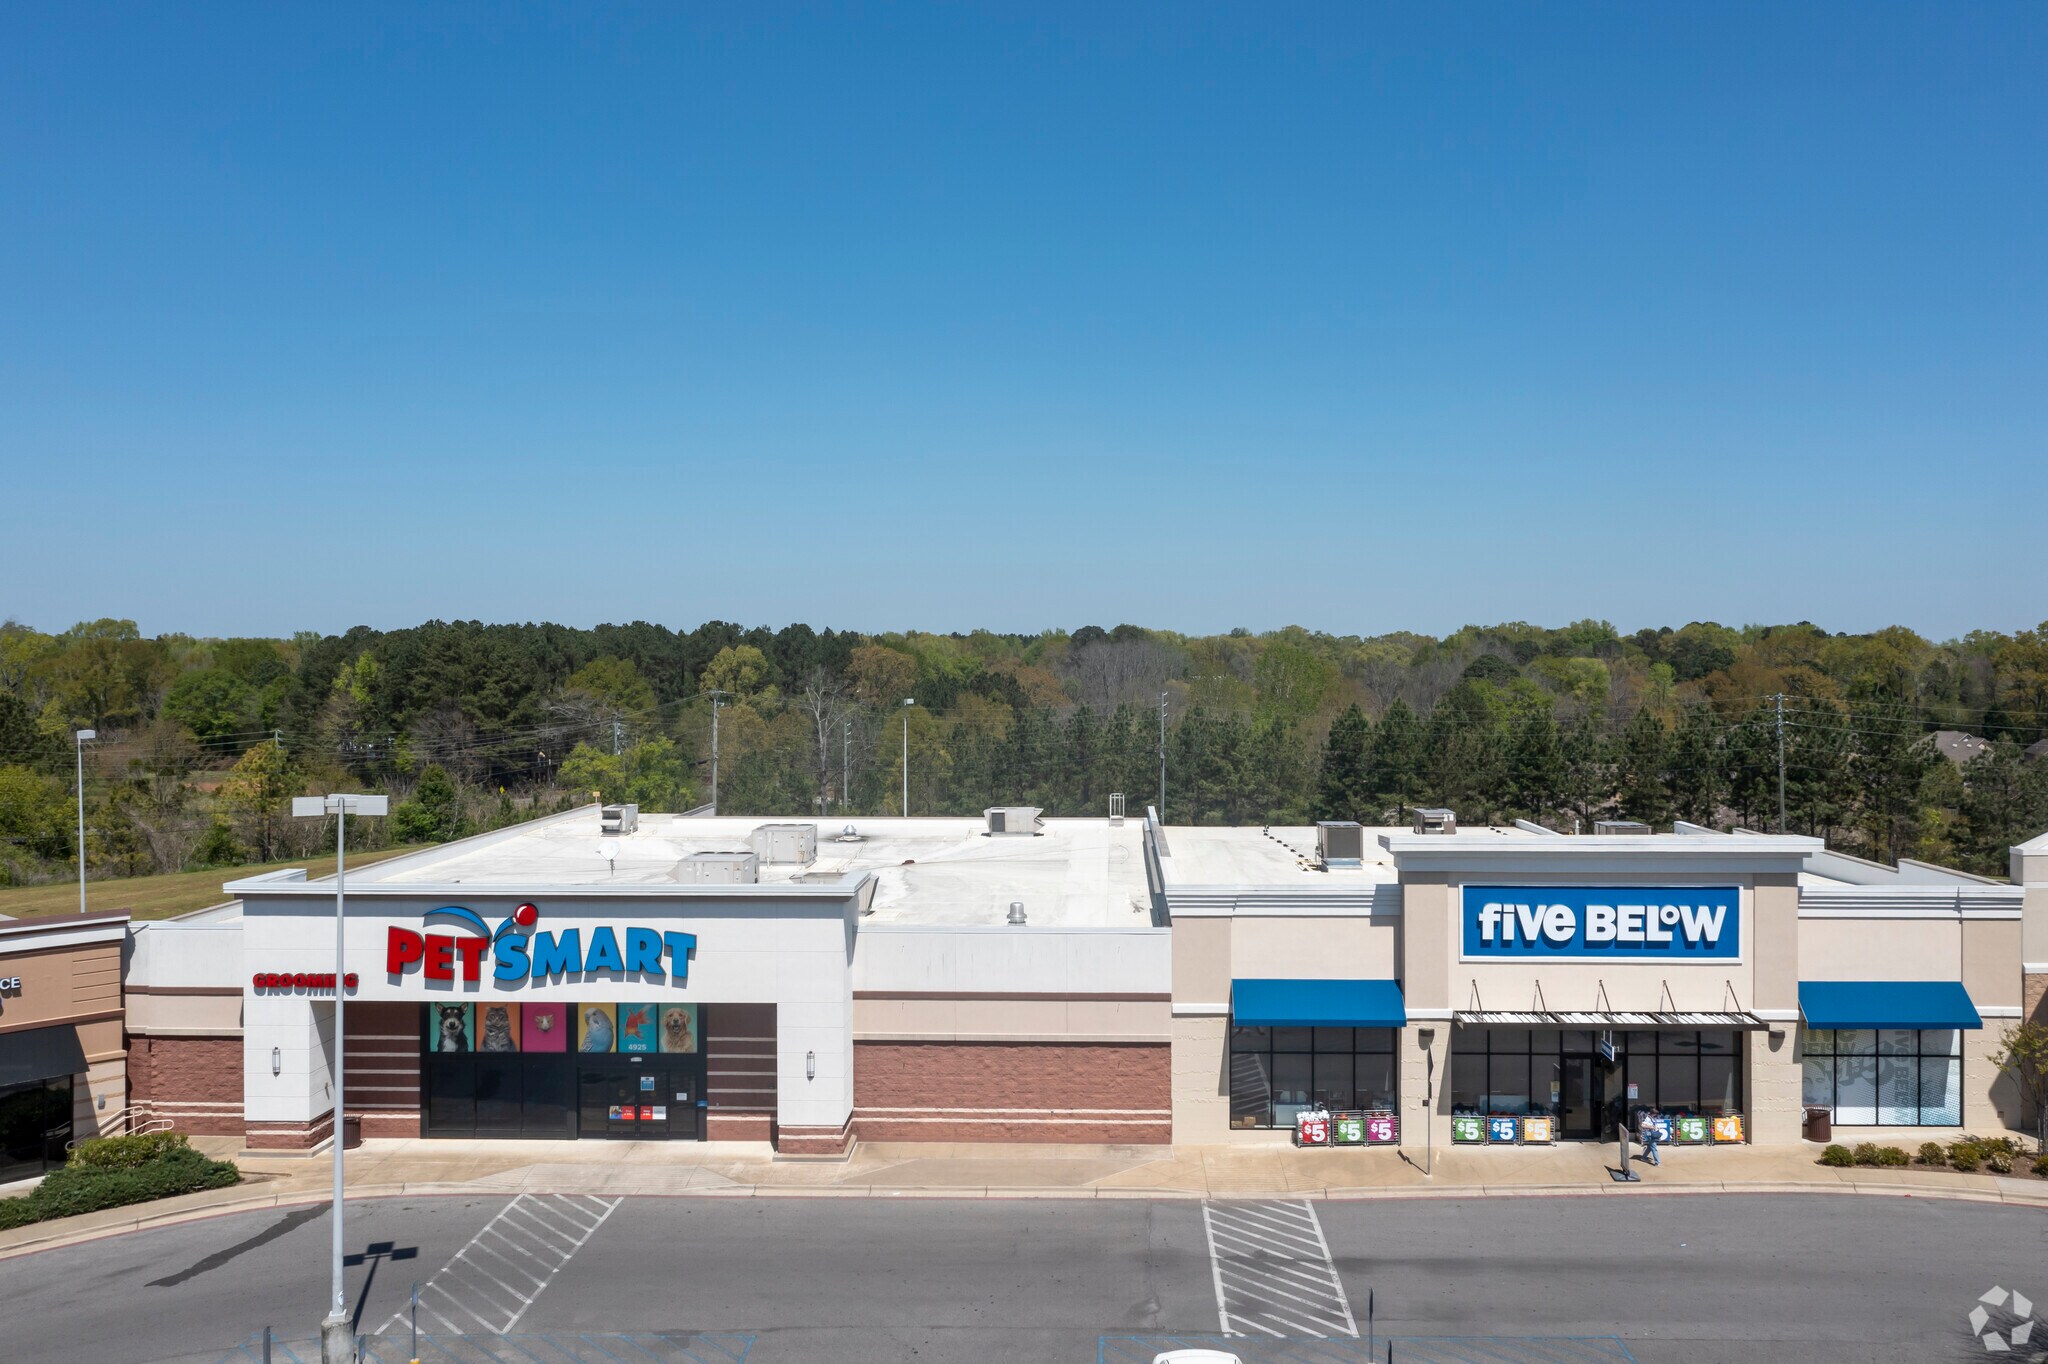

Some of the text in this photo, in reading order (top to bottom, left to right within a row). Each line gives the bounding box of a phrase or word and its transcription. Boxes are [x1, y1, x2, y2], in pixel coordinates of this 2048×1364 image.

[1478, 902, 1727, 941] five BELOW
[386, 924, 698, 981] PETSMART
[628, 1043, 647, 1051] 4925
[1304, 1124, 1326, 1142] $5
[1339, 1123, 1361, 1141] $5
[1370, 1122, 1392, 1141] $5
[1457, 1121, 1479, 1140] $5
[1492, 1121, 1514, 1140] $5
[1526, 1122, 1547, 1140] $5
[1682, 1121, 1704, 1140] $5
[1716, 1121, 1738, 1139] $4
